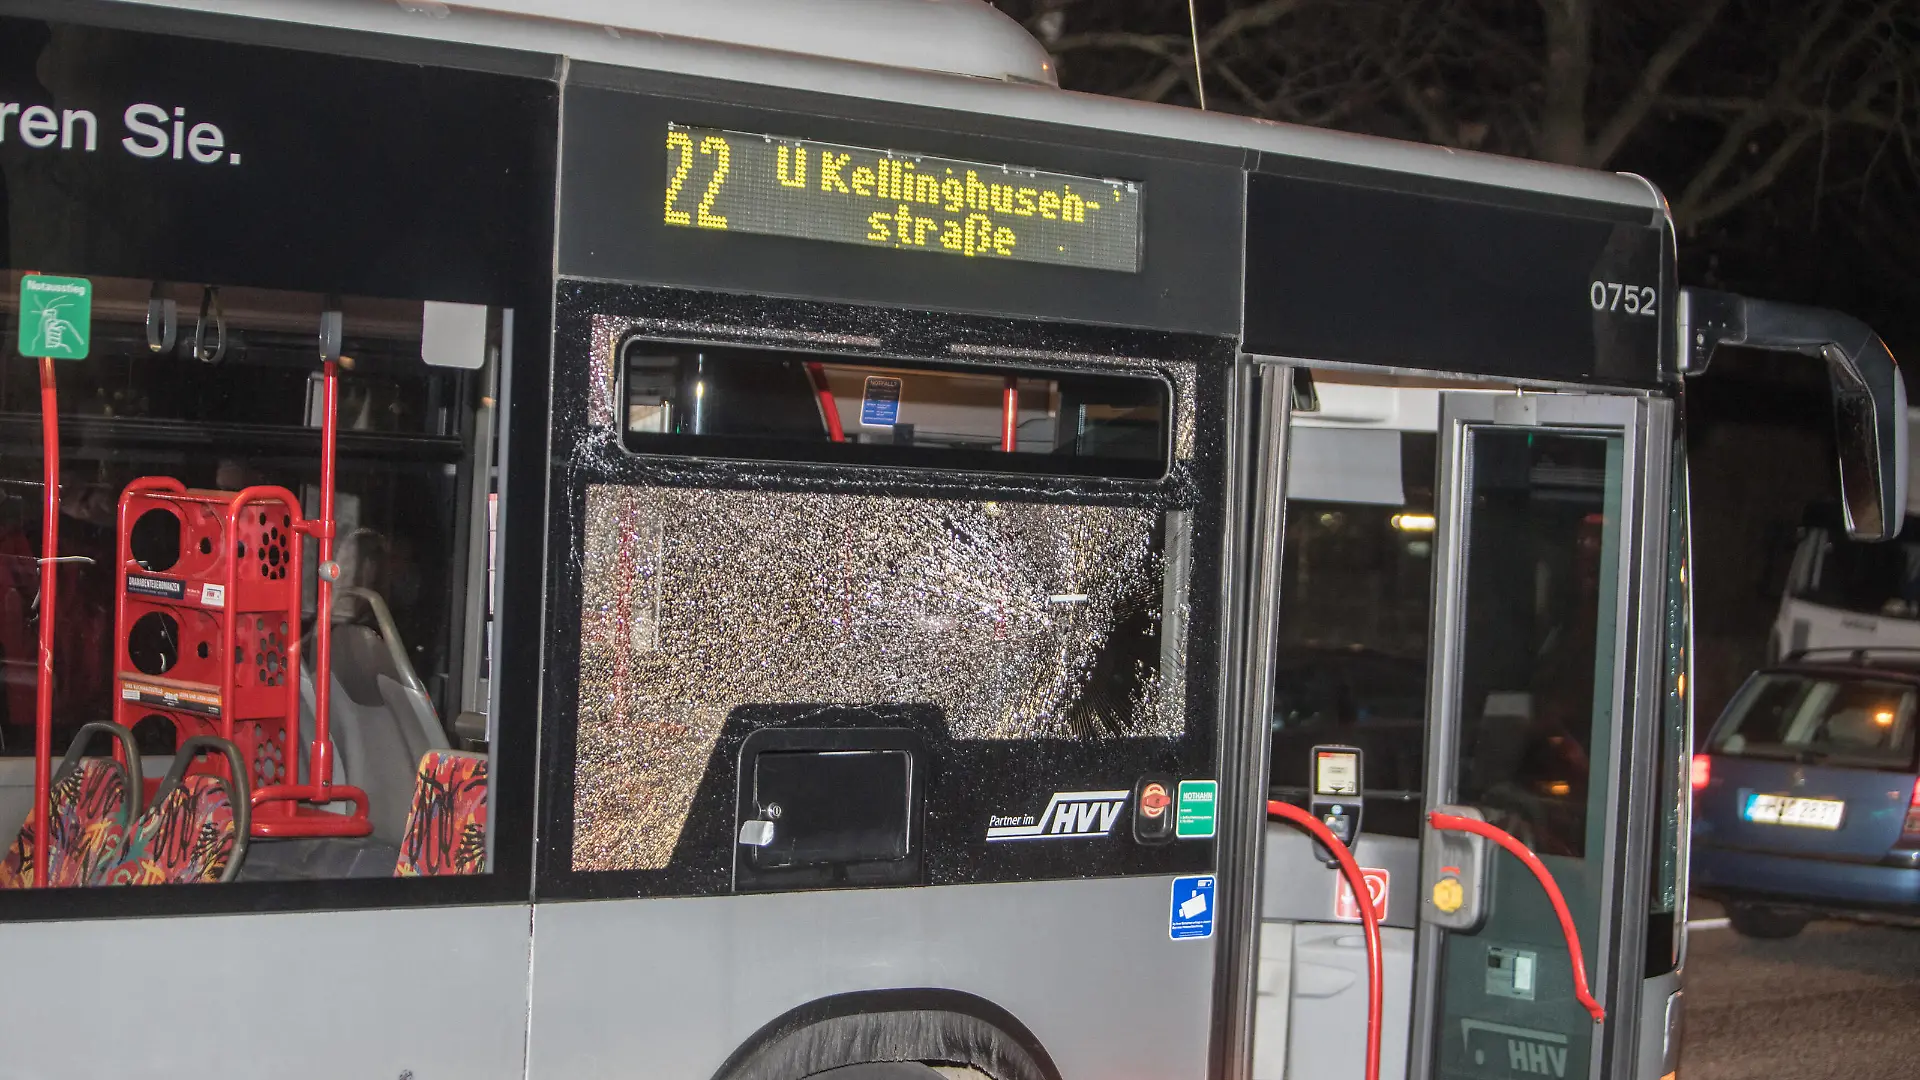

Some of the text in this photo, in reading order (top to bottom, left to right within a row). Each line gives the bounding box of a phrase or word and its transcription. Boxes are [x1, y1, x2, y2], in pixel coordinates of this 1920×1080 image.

[122, 103, 241, 165] Sie.
[664, 131, 730, 230] 22
[777, 145, 1101, 224] U Kellinghusen-
[867, 203, 1017, 257] straße
[27, 280, 86, 296] Notausstieg
[1590, 280, 1656, 315] 0752
[1183, 791, 1213, 801] NOTHAHN
[989, 813, 1035, 827] Partner im
[1051, 801, 1124, 834] HVV
